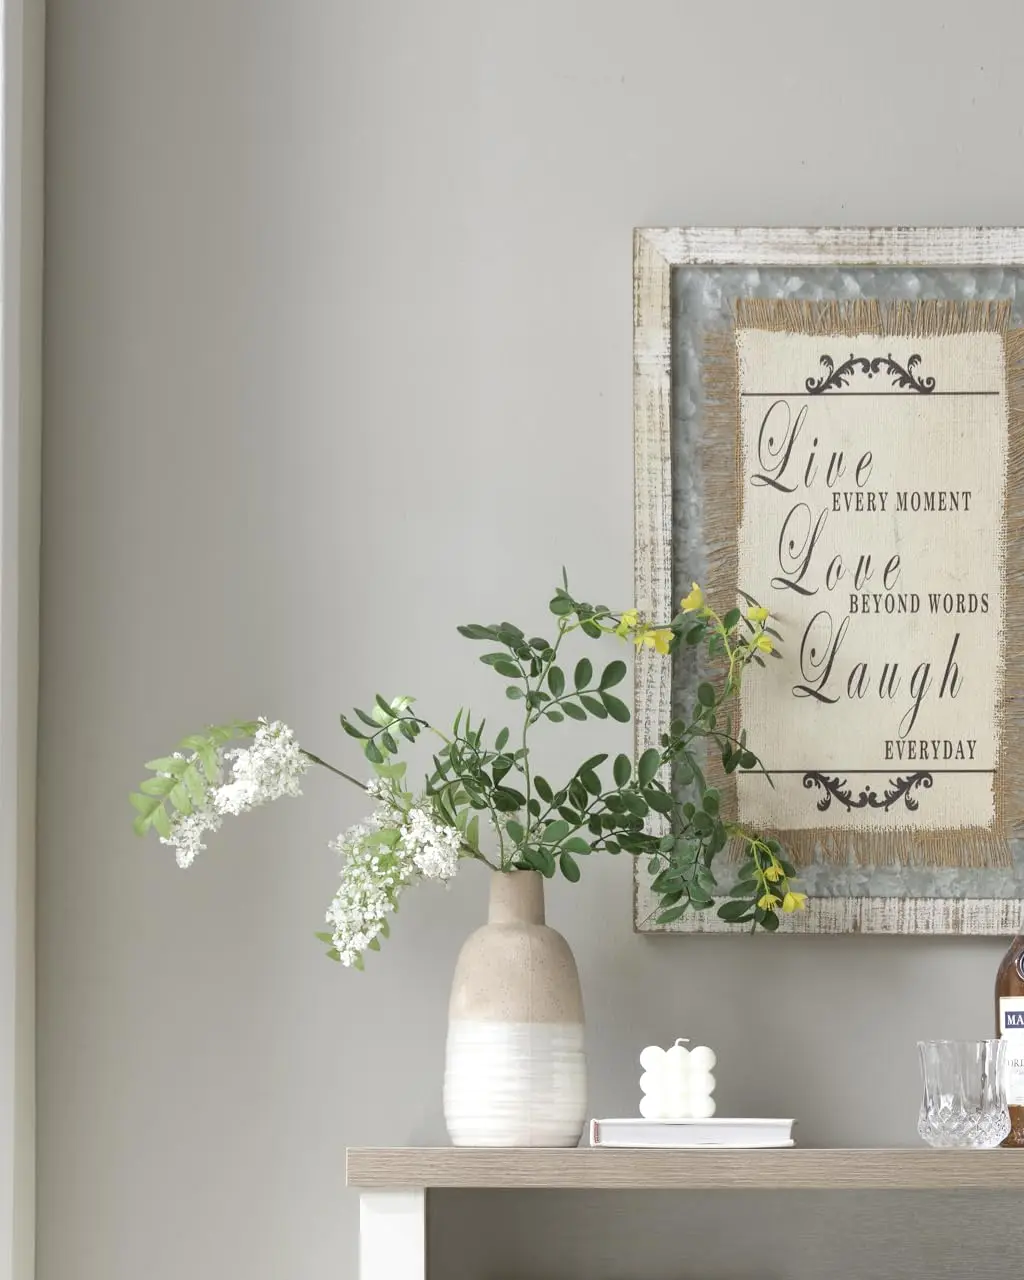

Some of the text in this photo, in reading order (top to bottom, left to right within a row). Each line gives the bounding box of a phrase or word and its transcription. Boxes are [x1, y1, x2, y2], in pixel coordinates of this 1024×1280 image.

[751, 400, 873, 493] Live
[833, 492, 971, 511] EVERY MOMENT
[771, 502, 901, 597] Love
[850, 593, 988, 613] BEYOND WORDS
[792, 610, 964, 738] Laugh
[885, 738, 976, 760] EVERYDAY
